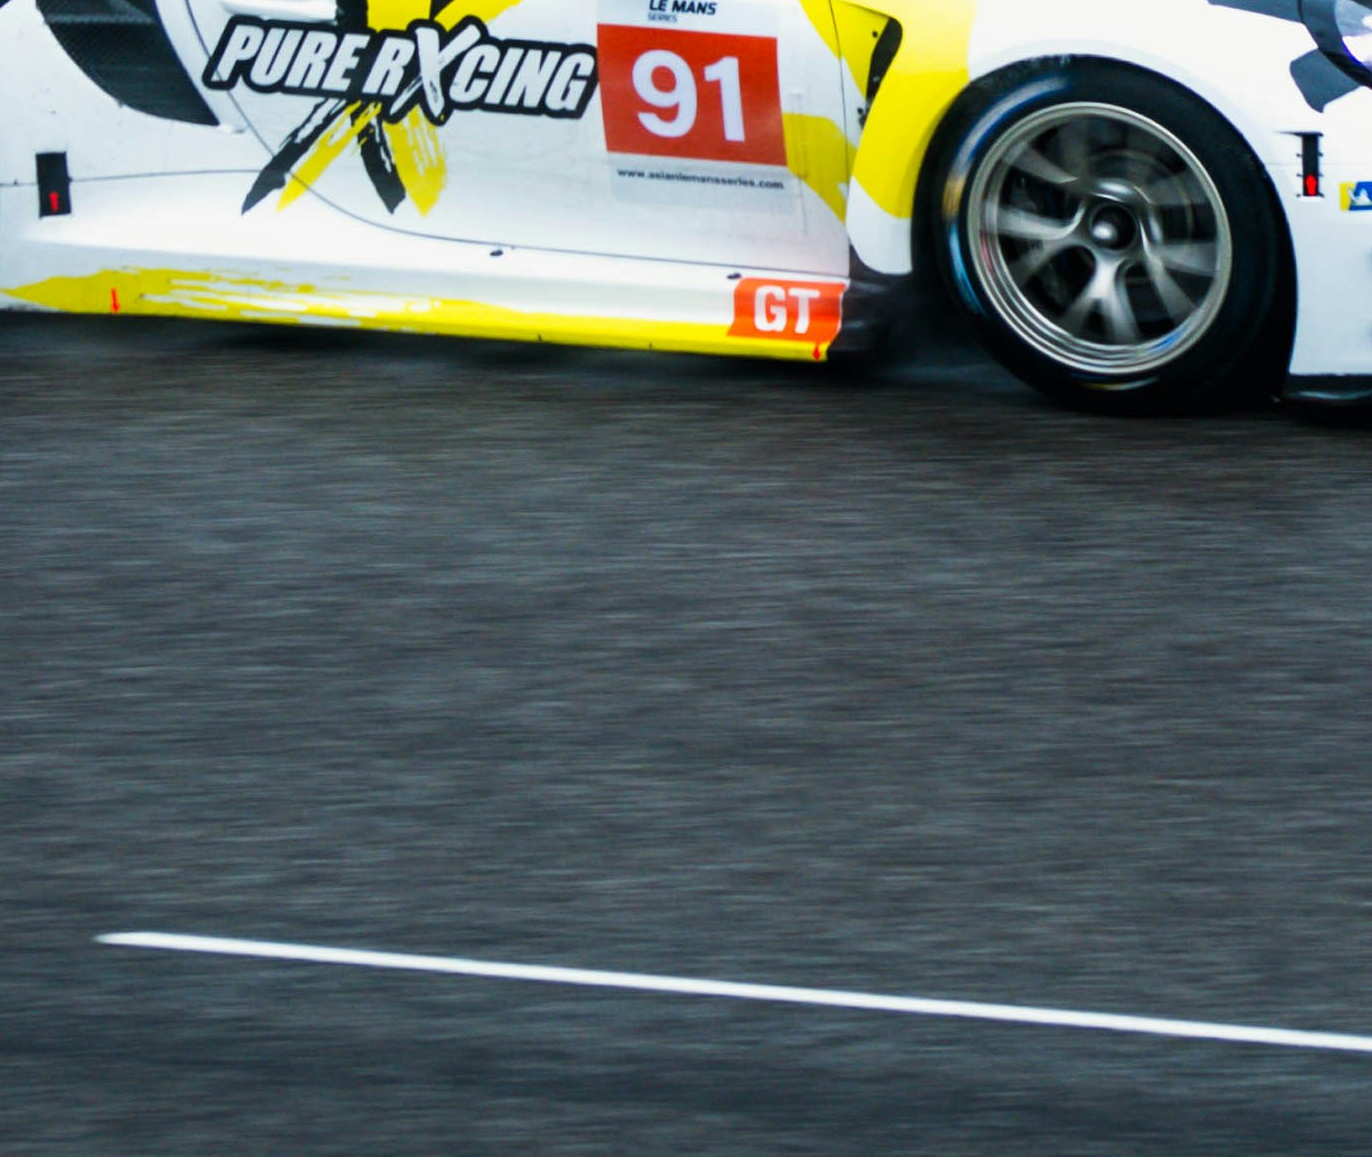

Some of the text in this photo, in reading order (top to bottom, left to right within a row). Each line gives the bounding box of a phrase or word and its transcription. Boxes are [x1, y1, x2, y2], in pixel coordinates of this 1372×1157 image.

[210, 23, 371, 94] PURE
[631, 48, 746, 143] 91
[616, 168, 785, 190] www.asianlemansseries.com
[754, 285, 820, 335] GT
